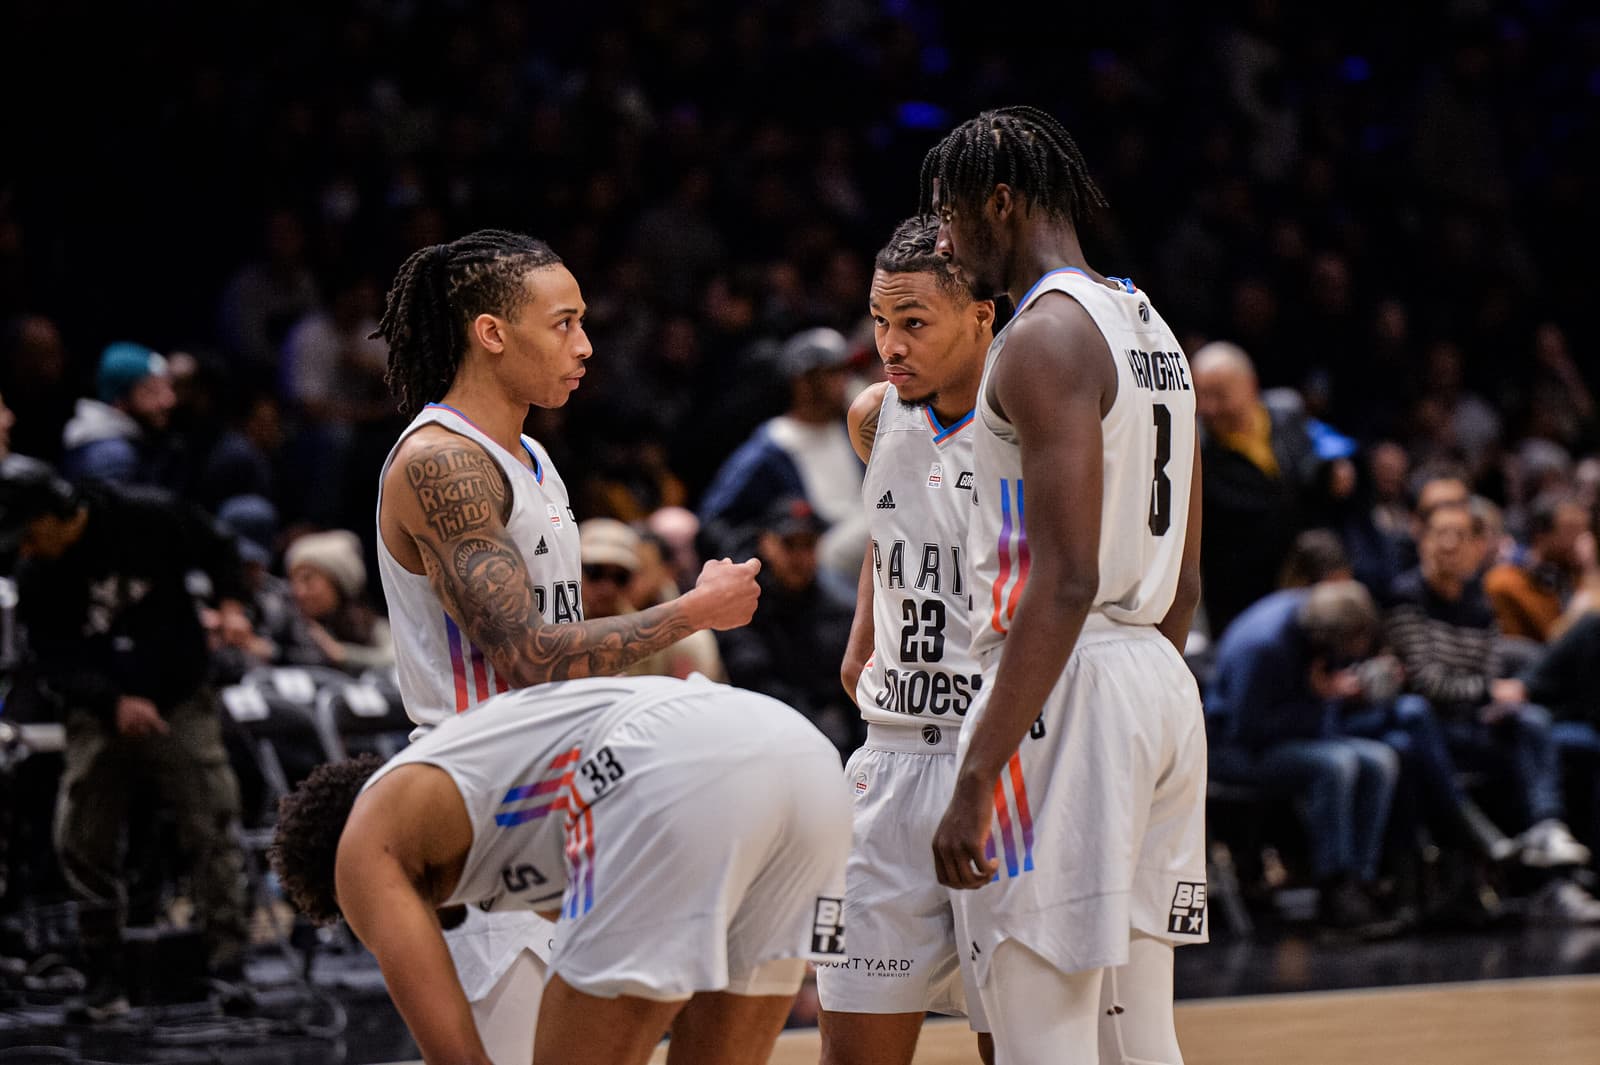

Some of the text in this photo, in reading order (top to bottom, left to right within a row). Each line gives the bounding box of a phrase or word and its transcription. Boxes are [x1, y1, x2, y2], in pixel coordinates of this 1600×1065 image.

[457, 541, 500, 577] BROOKLYN
[900, 599, 946, 663] 23
[581, 746, 625, 795] 33
